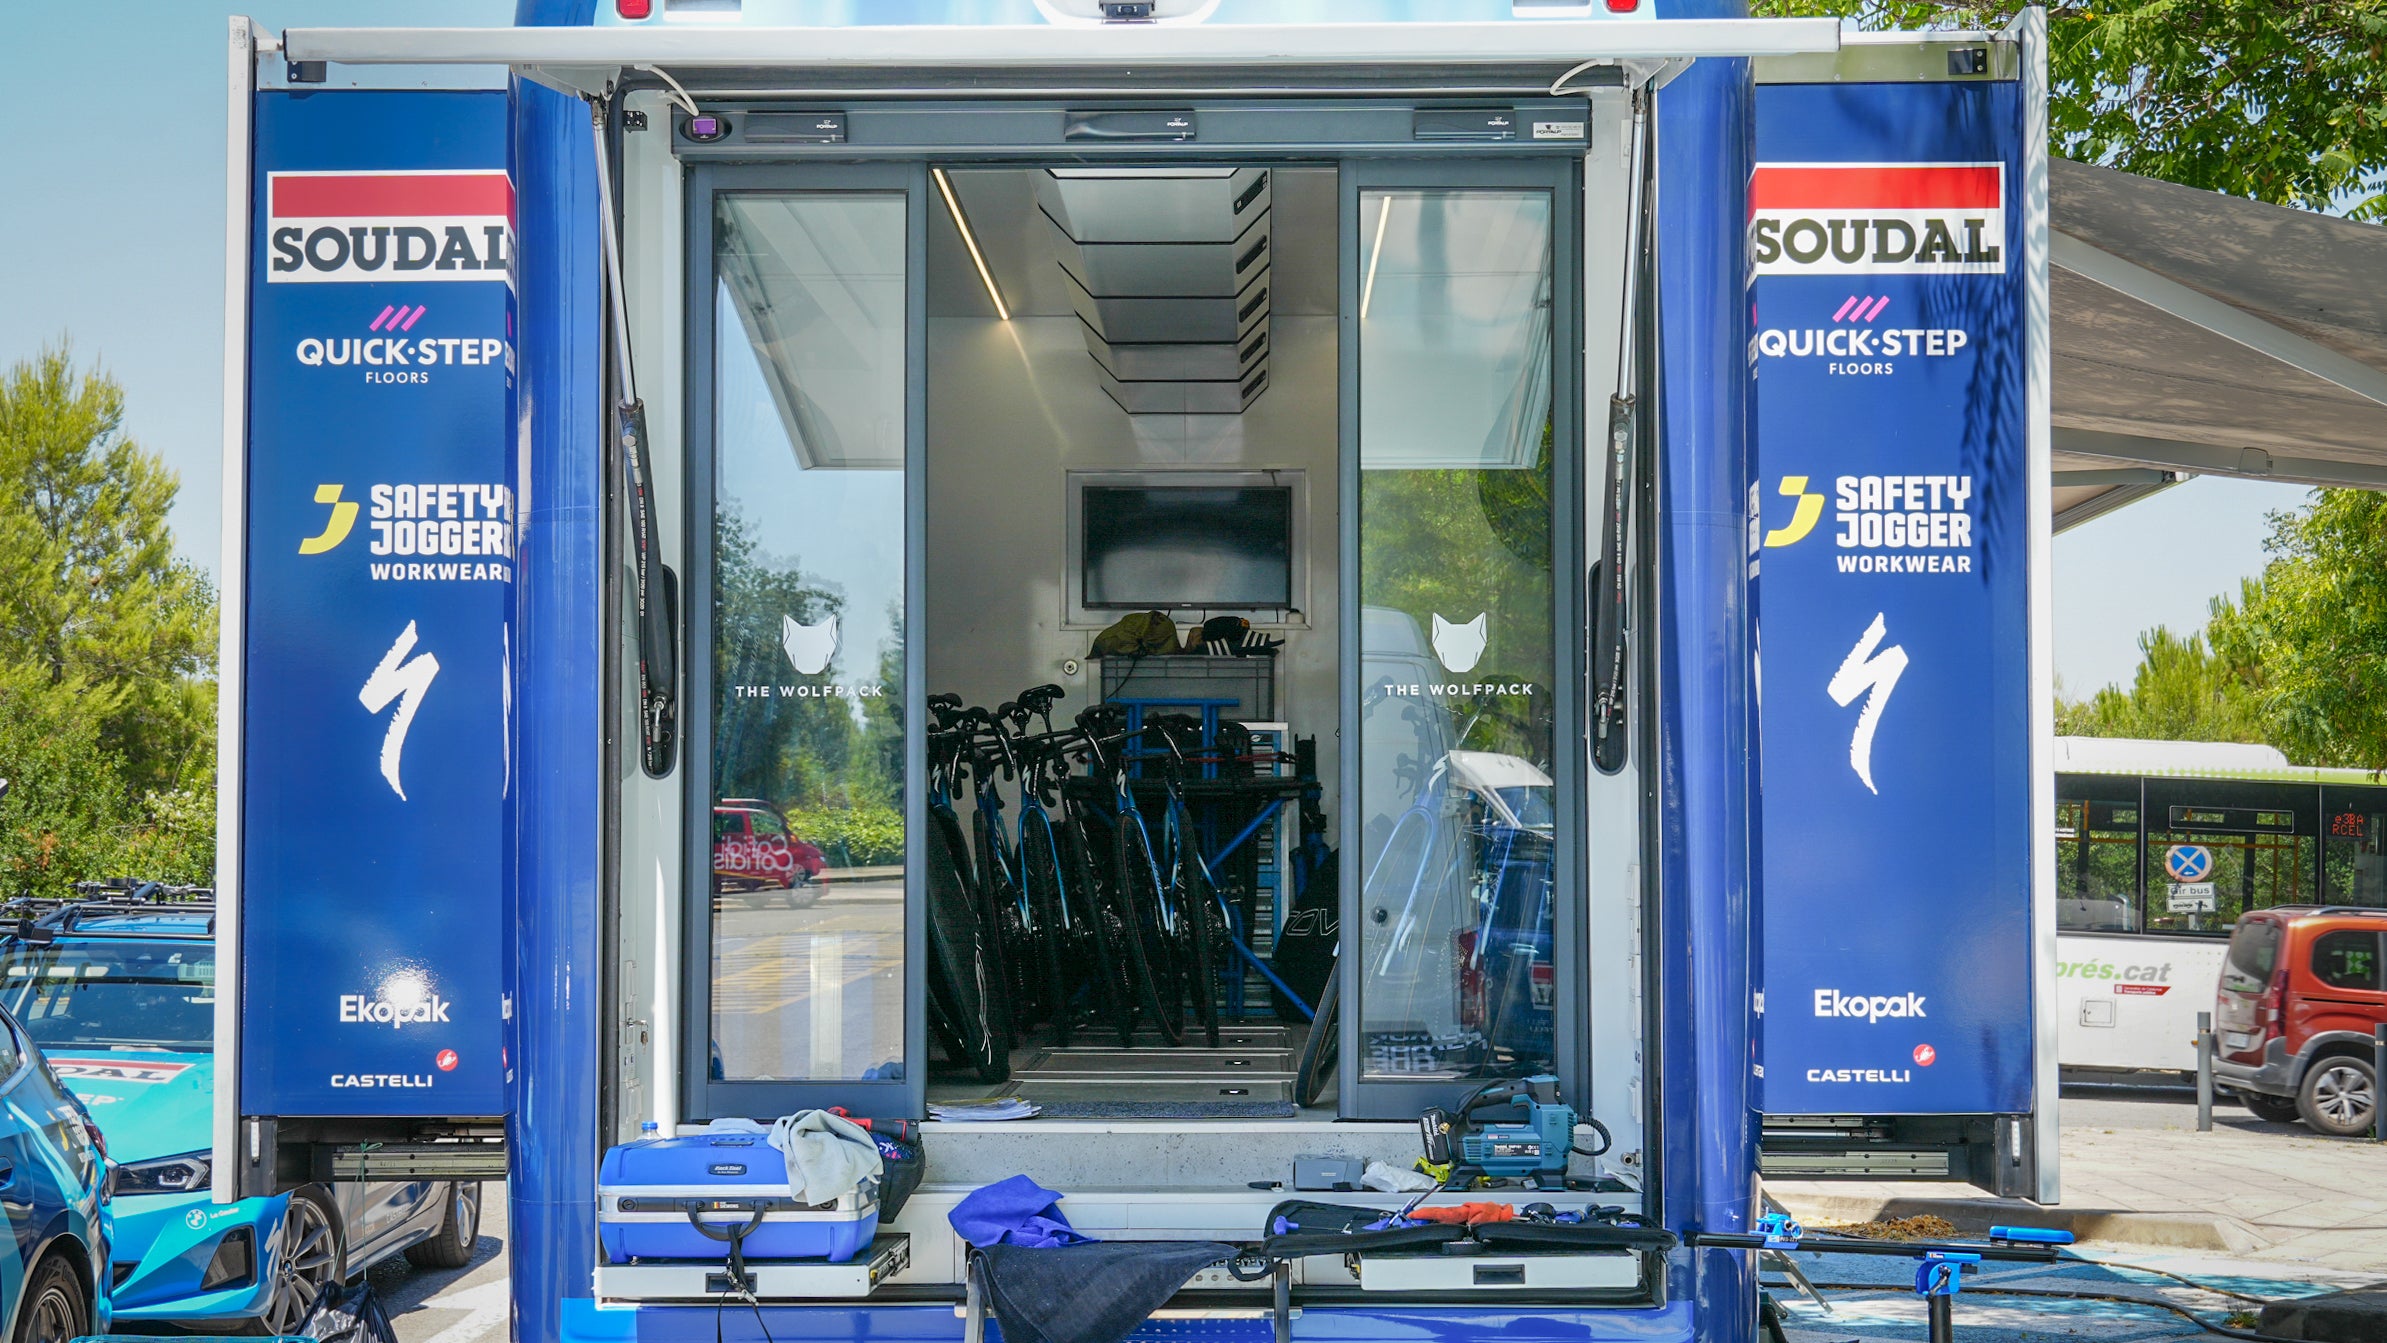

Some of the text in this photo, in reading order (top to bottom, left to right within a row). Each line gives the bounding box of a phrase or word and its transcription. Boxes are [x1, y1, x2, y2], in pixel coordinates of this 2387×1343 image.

[1757, 219, 1999, 263] SOUDAL
[1829, 362, 1893, 375] FLOORS
[366, 372, 429, 384] FLOORS
[371, 484, 503, 518] SAFETY
[1836, 476, 1971, 511] SAFETY
[371, 520, 503, 556] JOGGER
[1836, 511, 1971, 548] JOGGER
[371, 564, 502, 581] WORKWEAR
[1836, 556, 1971, 573] WORKWEAR
[735, 686, 884, 697] THE WOLFPACK
[1384, 685, 1533, 696] THE WOLFPACK
[2189, 887, 2210, 895] bus
[339, 994, 450, 1029] Ekopak
[1814, 988, 1927, 1024] Ekopak
[331, 1074, 433, 1088] CASTELLI
[1806, 1069, 1910, 1083] CASTELLI
